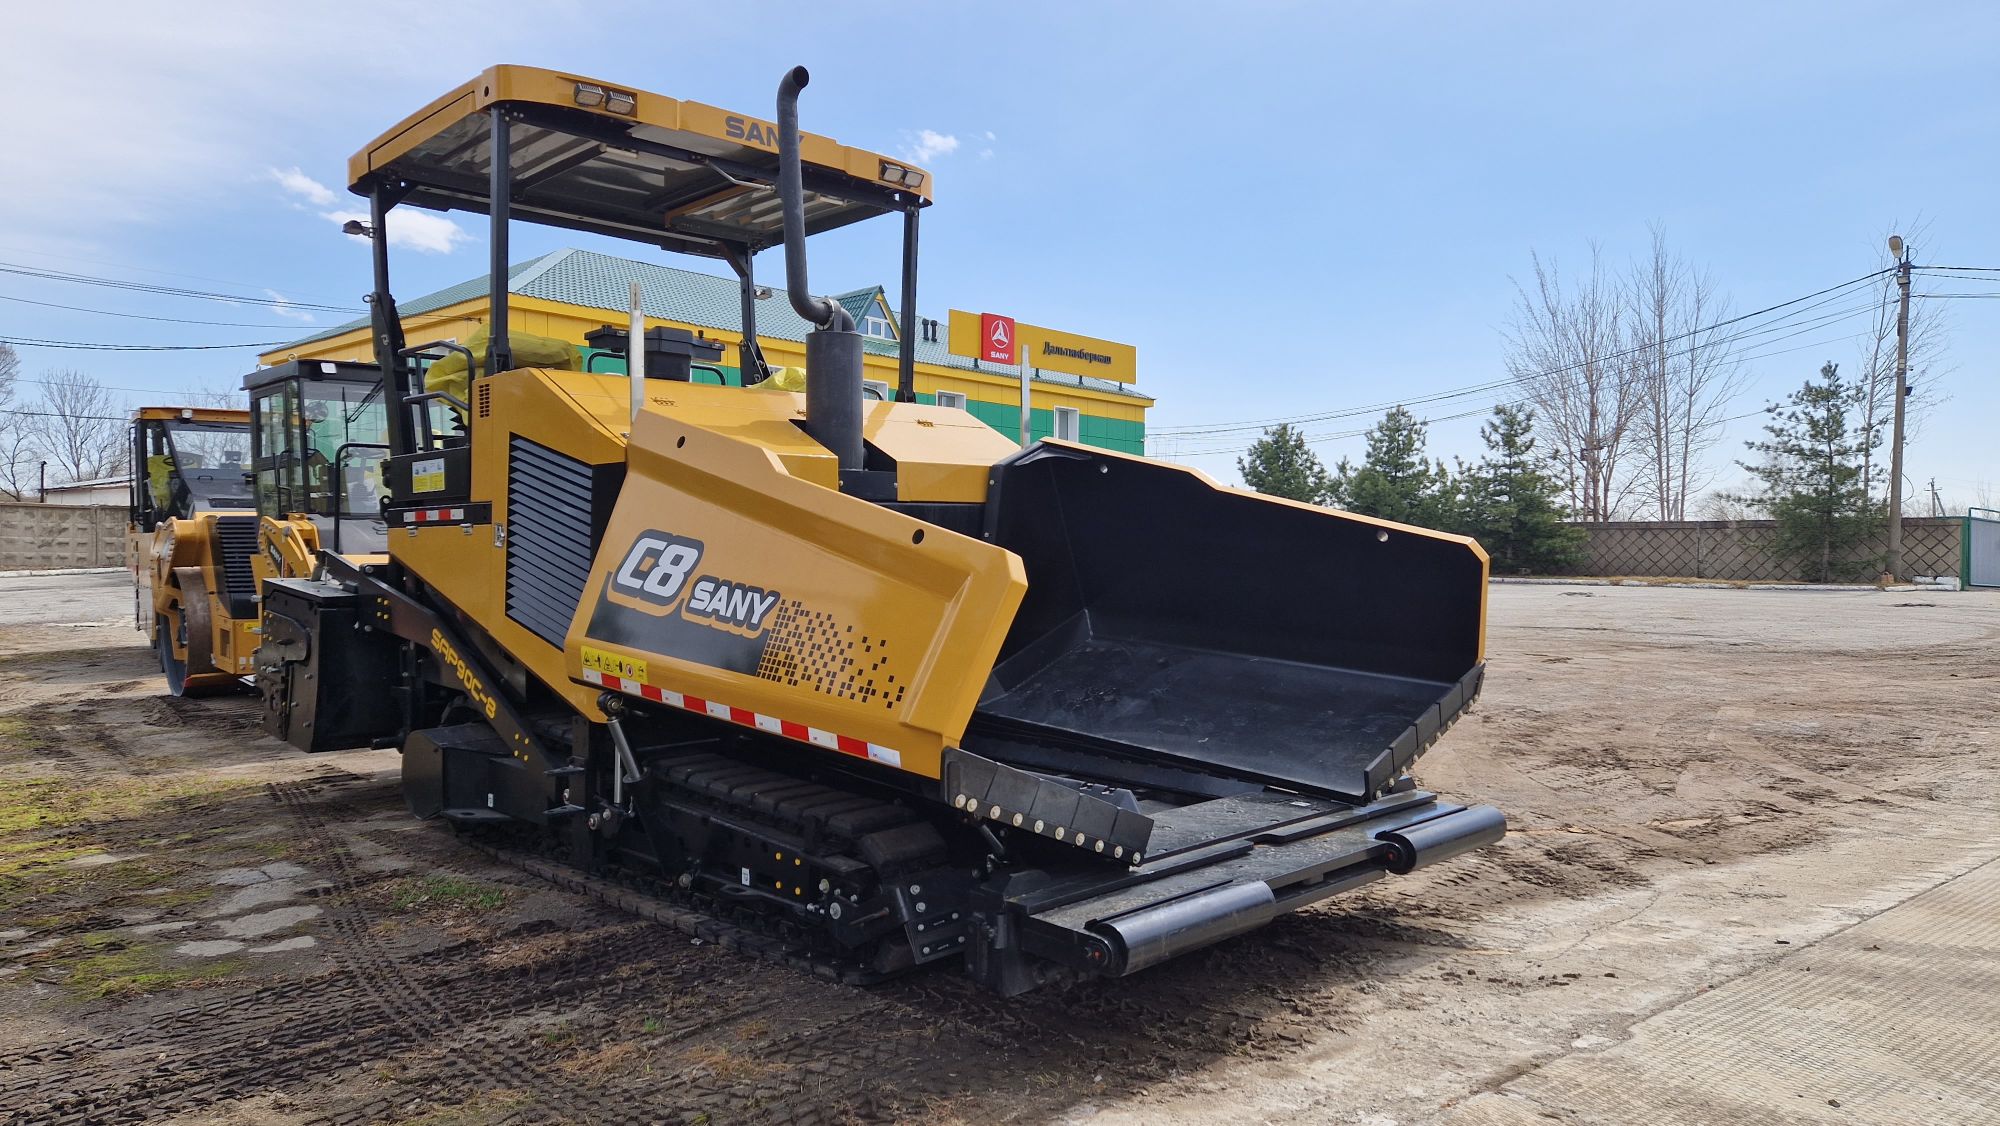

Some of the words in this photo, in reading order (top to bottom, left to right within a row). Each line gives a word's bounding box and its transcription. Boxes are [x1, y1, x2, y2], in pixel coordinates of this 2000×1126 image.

[725, 116, 804, 147] SAN
[990, 351, 1008, 360] SANY
[616, 537, 699, 598] C8
[689, 580, 775, 625] SANY
[431, 628, 497, 720] SAP90C-8
